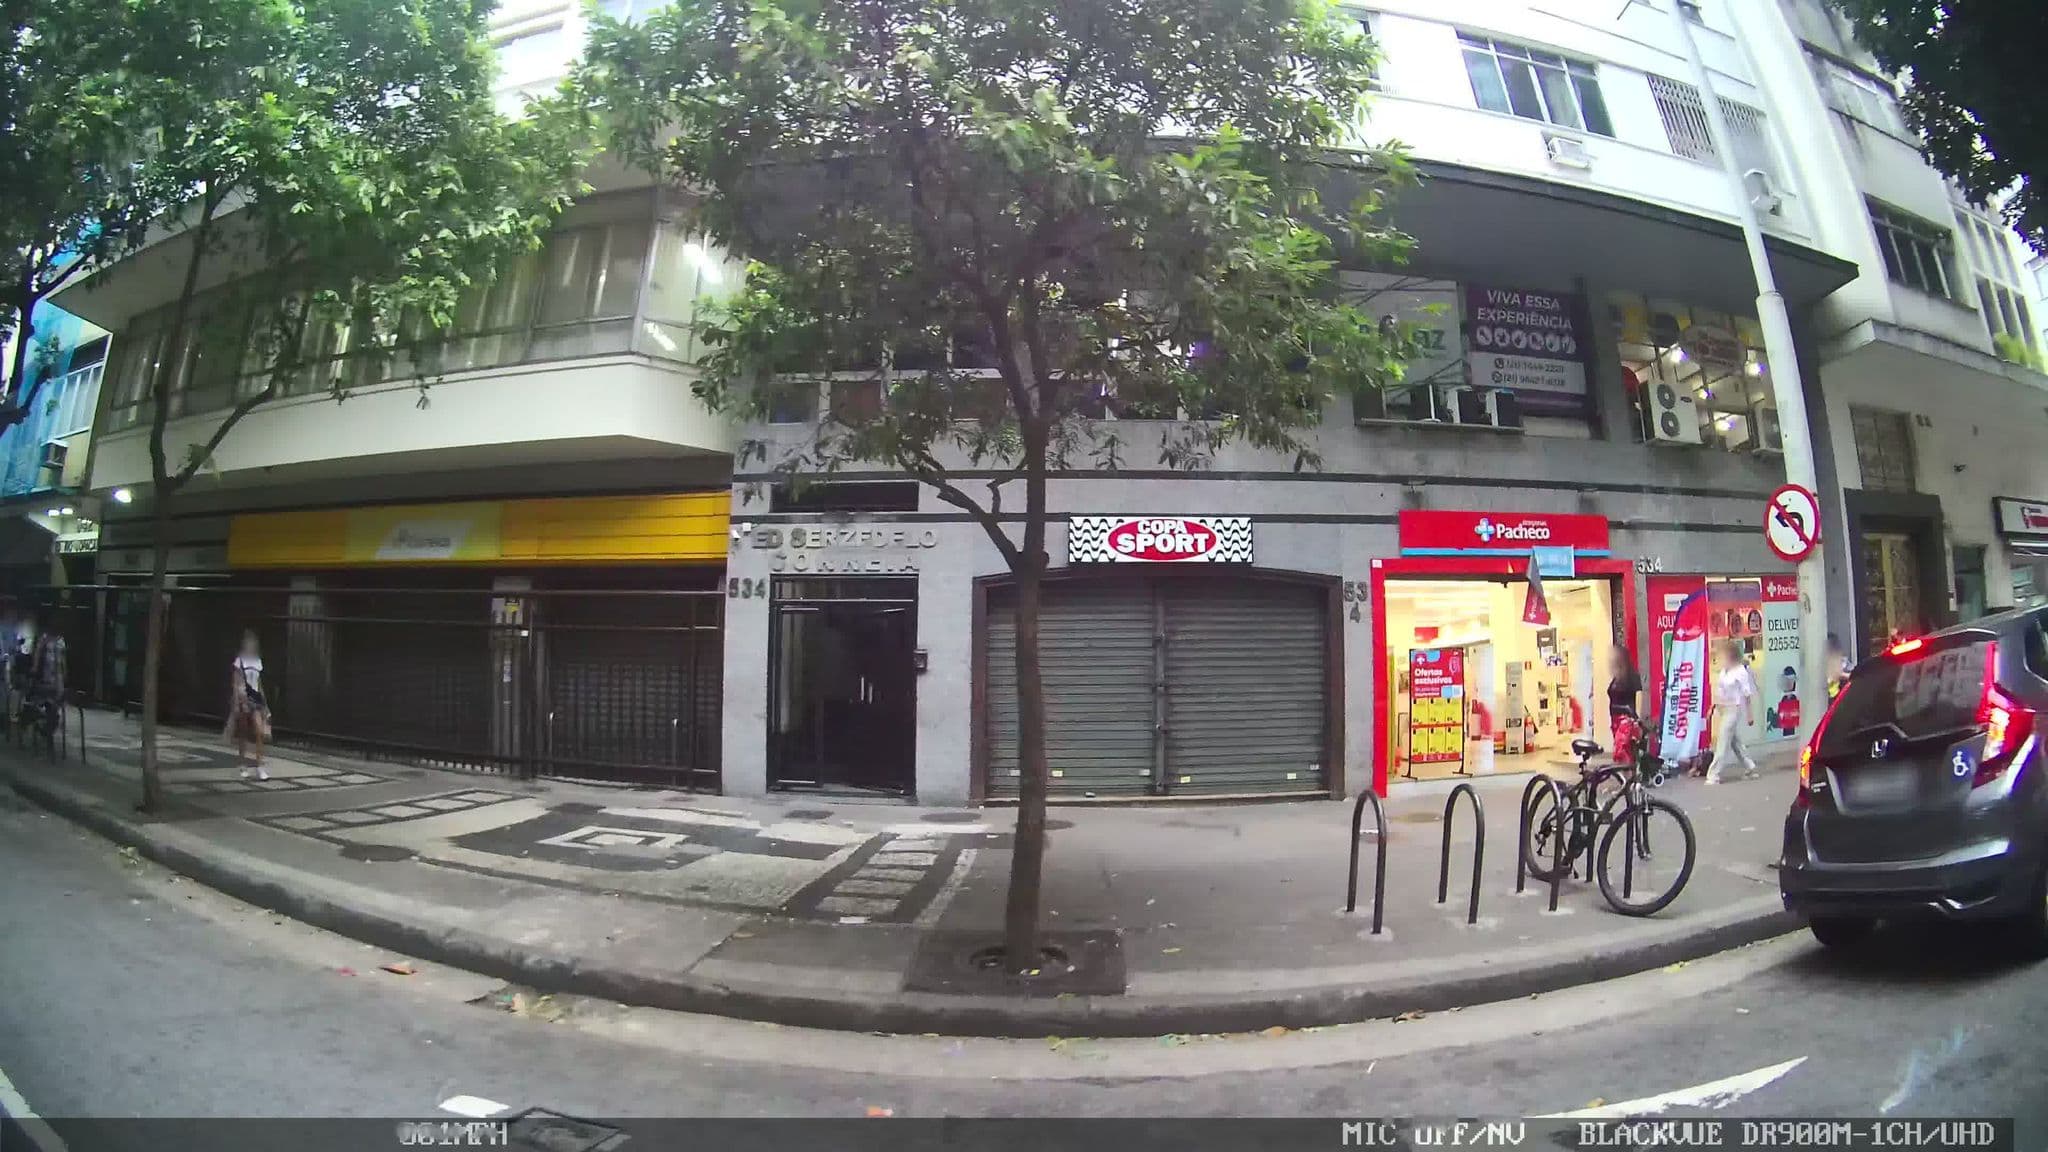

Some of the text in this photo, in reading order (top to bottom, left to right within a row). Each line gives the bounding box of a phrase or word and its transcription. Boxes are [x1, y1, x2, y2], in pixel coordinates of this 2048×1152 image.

[1487, 289, 1561, 311] VIVA ESSA
[1477, 307, 1573, 330] EXPERIÊNCIA
[1137, 519, 1188, 534] COPA
[1495, 522, 1551, 540] Pacheco
[1116, 532, 1210, 554] SPORT
[728, 577, 766, 600] 534
